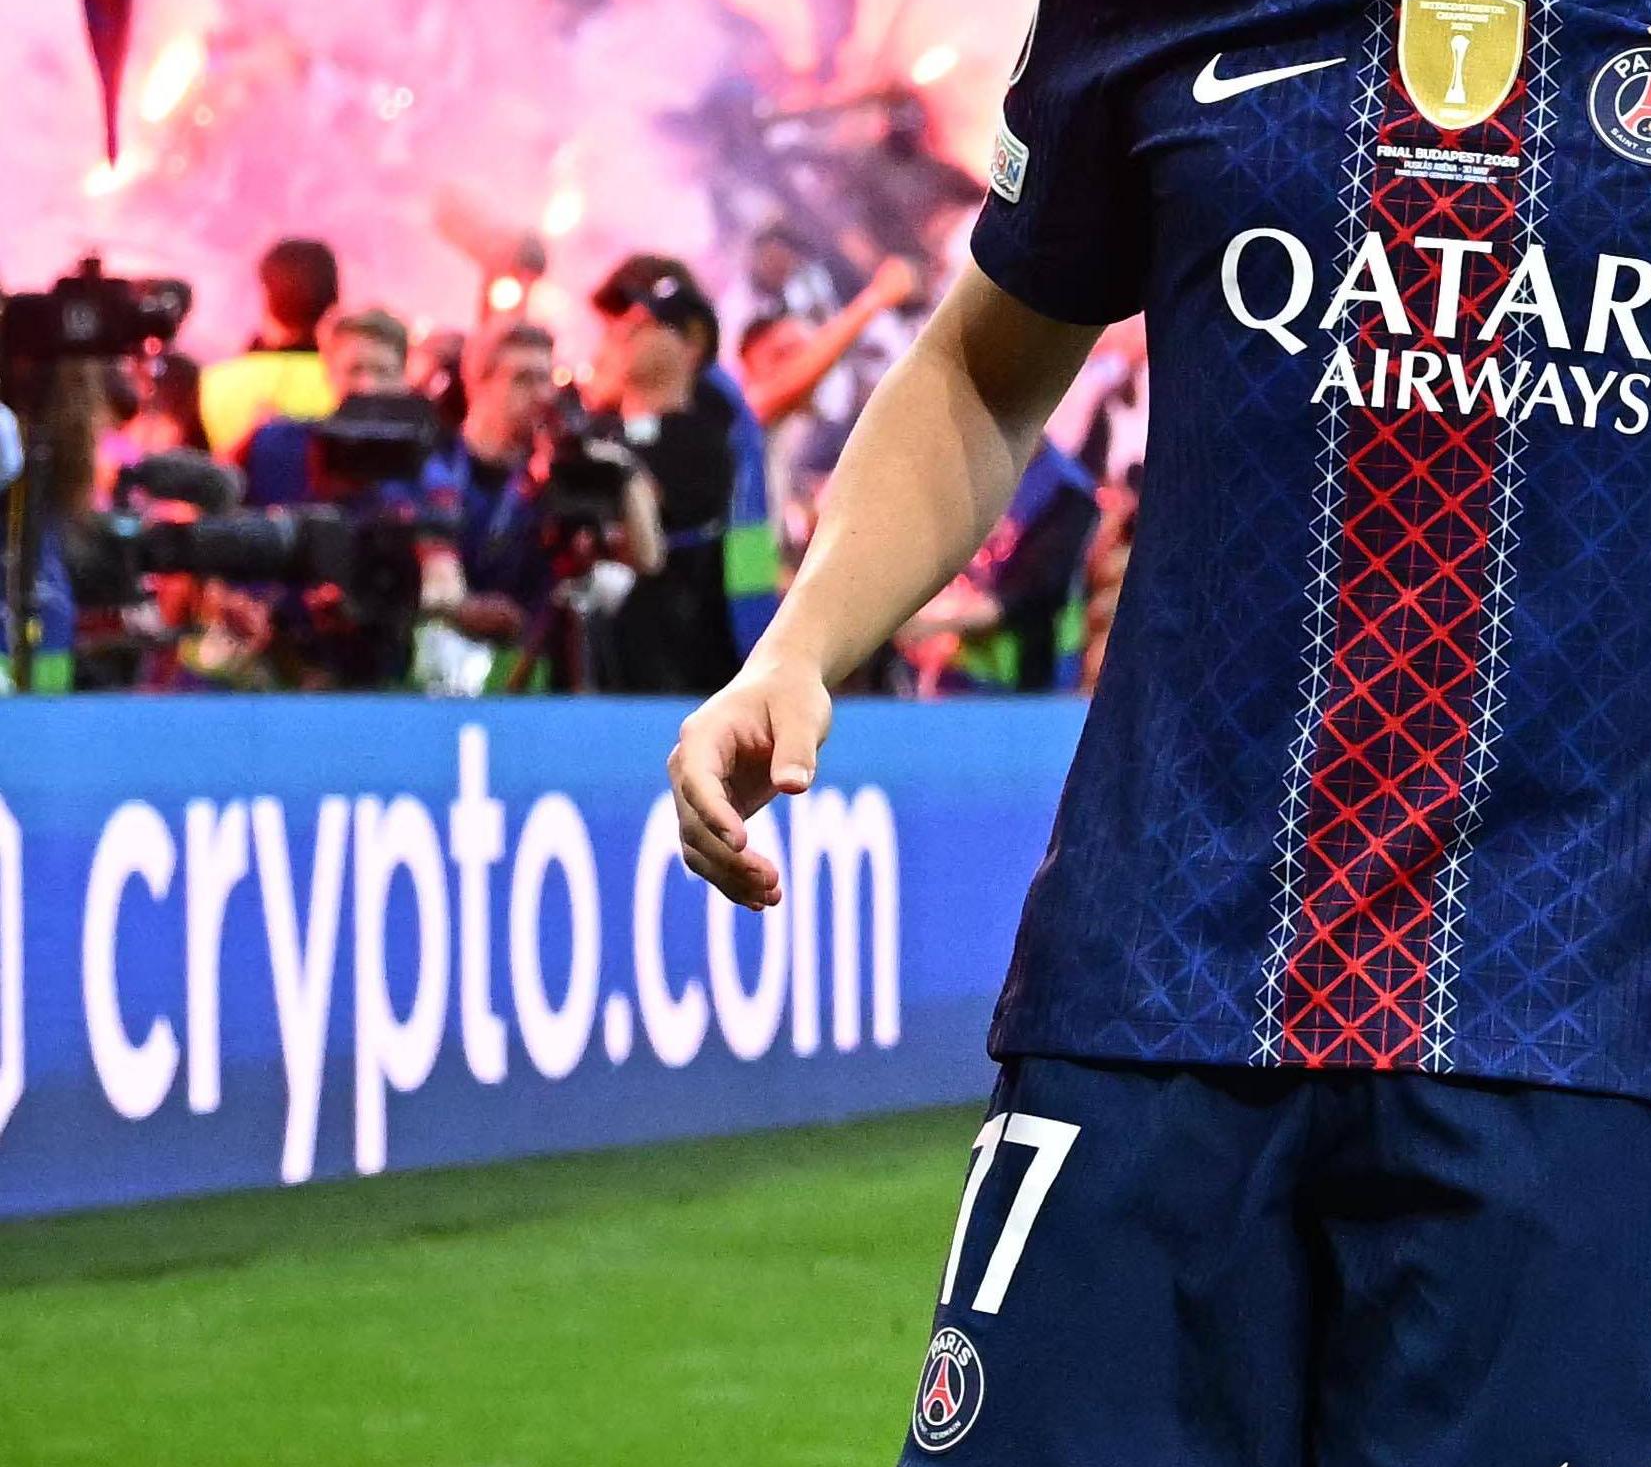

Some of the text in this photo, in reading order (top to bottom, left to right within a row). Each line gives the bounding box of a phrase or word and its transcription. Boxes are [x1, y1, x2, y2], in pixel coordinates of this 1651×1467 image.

[1377, 145, 1413, 158] FINAL
[1415, 147, 1483, 164] BUDAPEST
[1310, 345, 1651, 435] AIRWAYS
[82, 724, 902, 1184] crypto.com
[941, 1112, 1081, 1314] 17
[931, 1336, 972, 1368] PARIS
